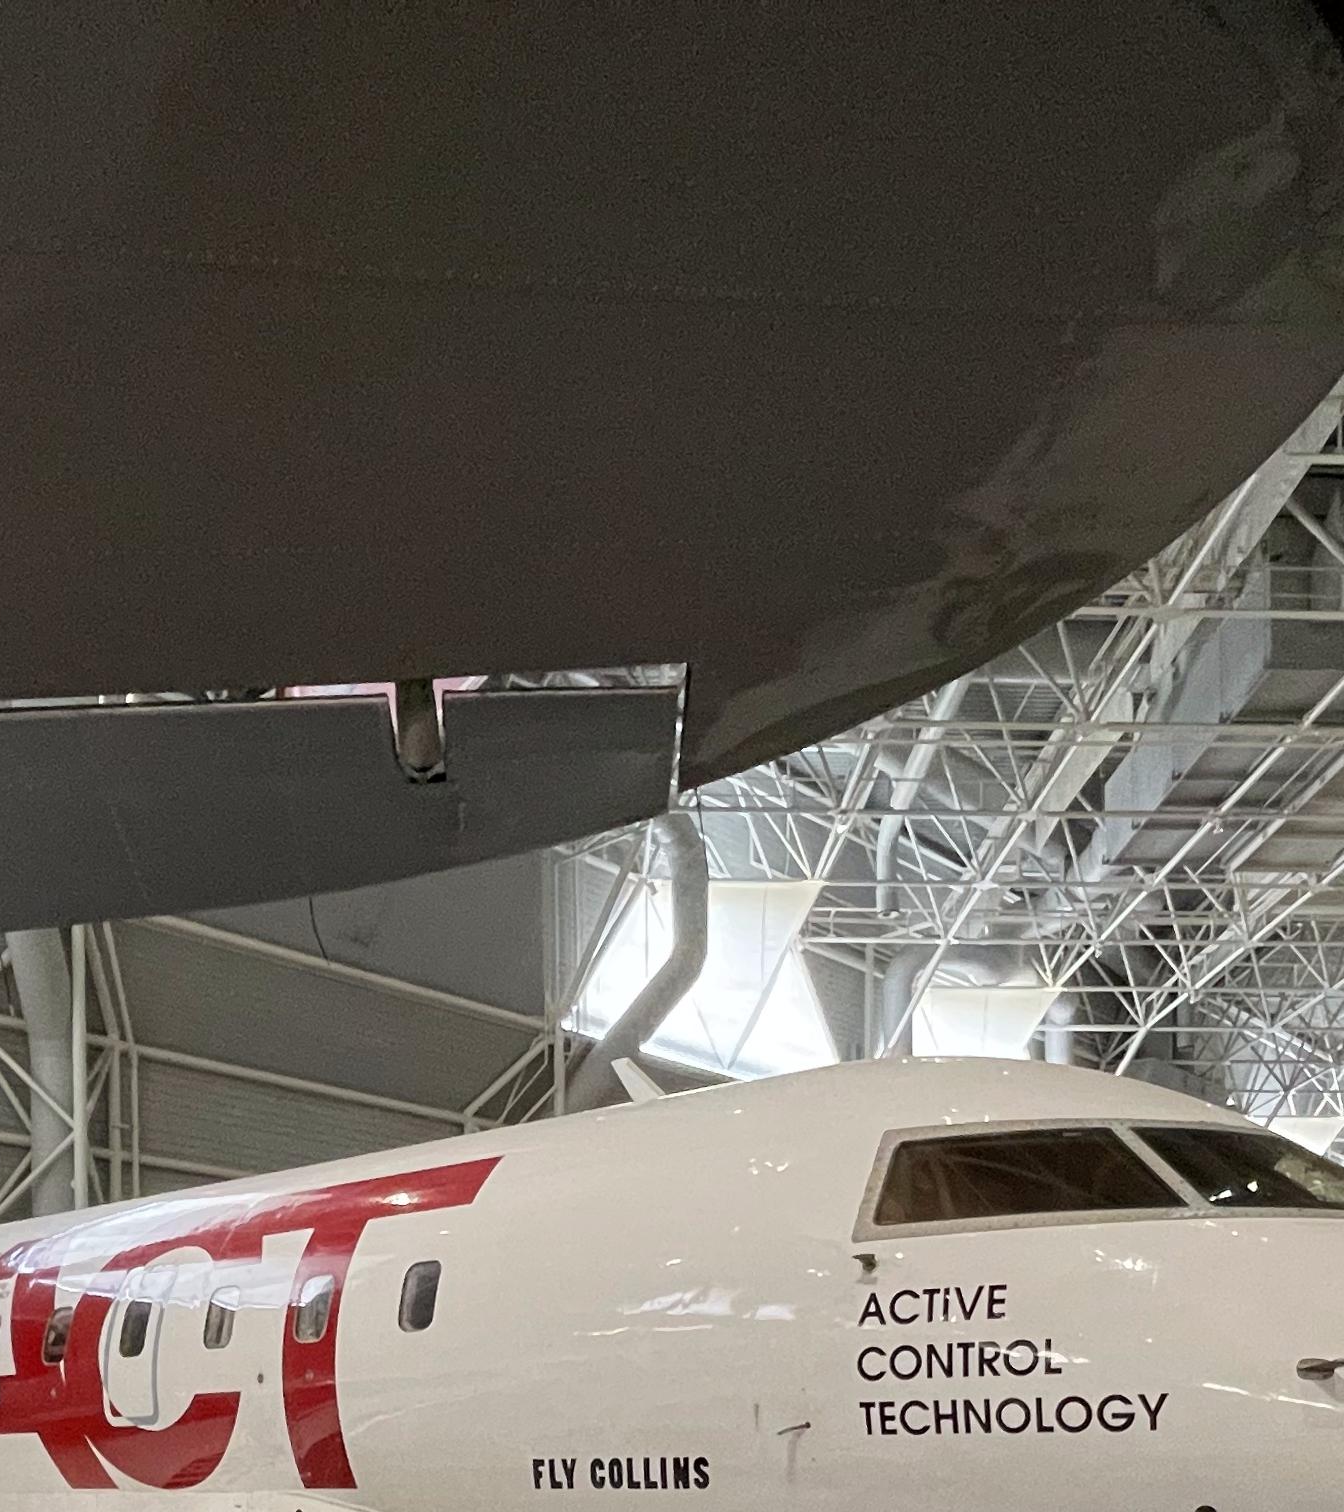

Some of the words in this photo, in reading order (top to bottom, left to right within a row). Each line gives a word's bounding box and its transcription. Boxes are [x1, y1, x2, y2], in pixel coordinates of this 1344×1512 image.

[858, 1284, 1007, 1325] ACTIVE
[857, 1338, 1062, 1382] CONTROL
[859, 1392, 1169, 1436] TECHNOLOGY
[532, 1458, 577, 1490] FLY
[590, 1456, 710, 1490] COLLINS
